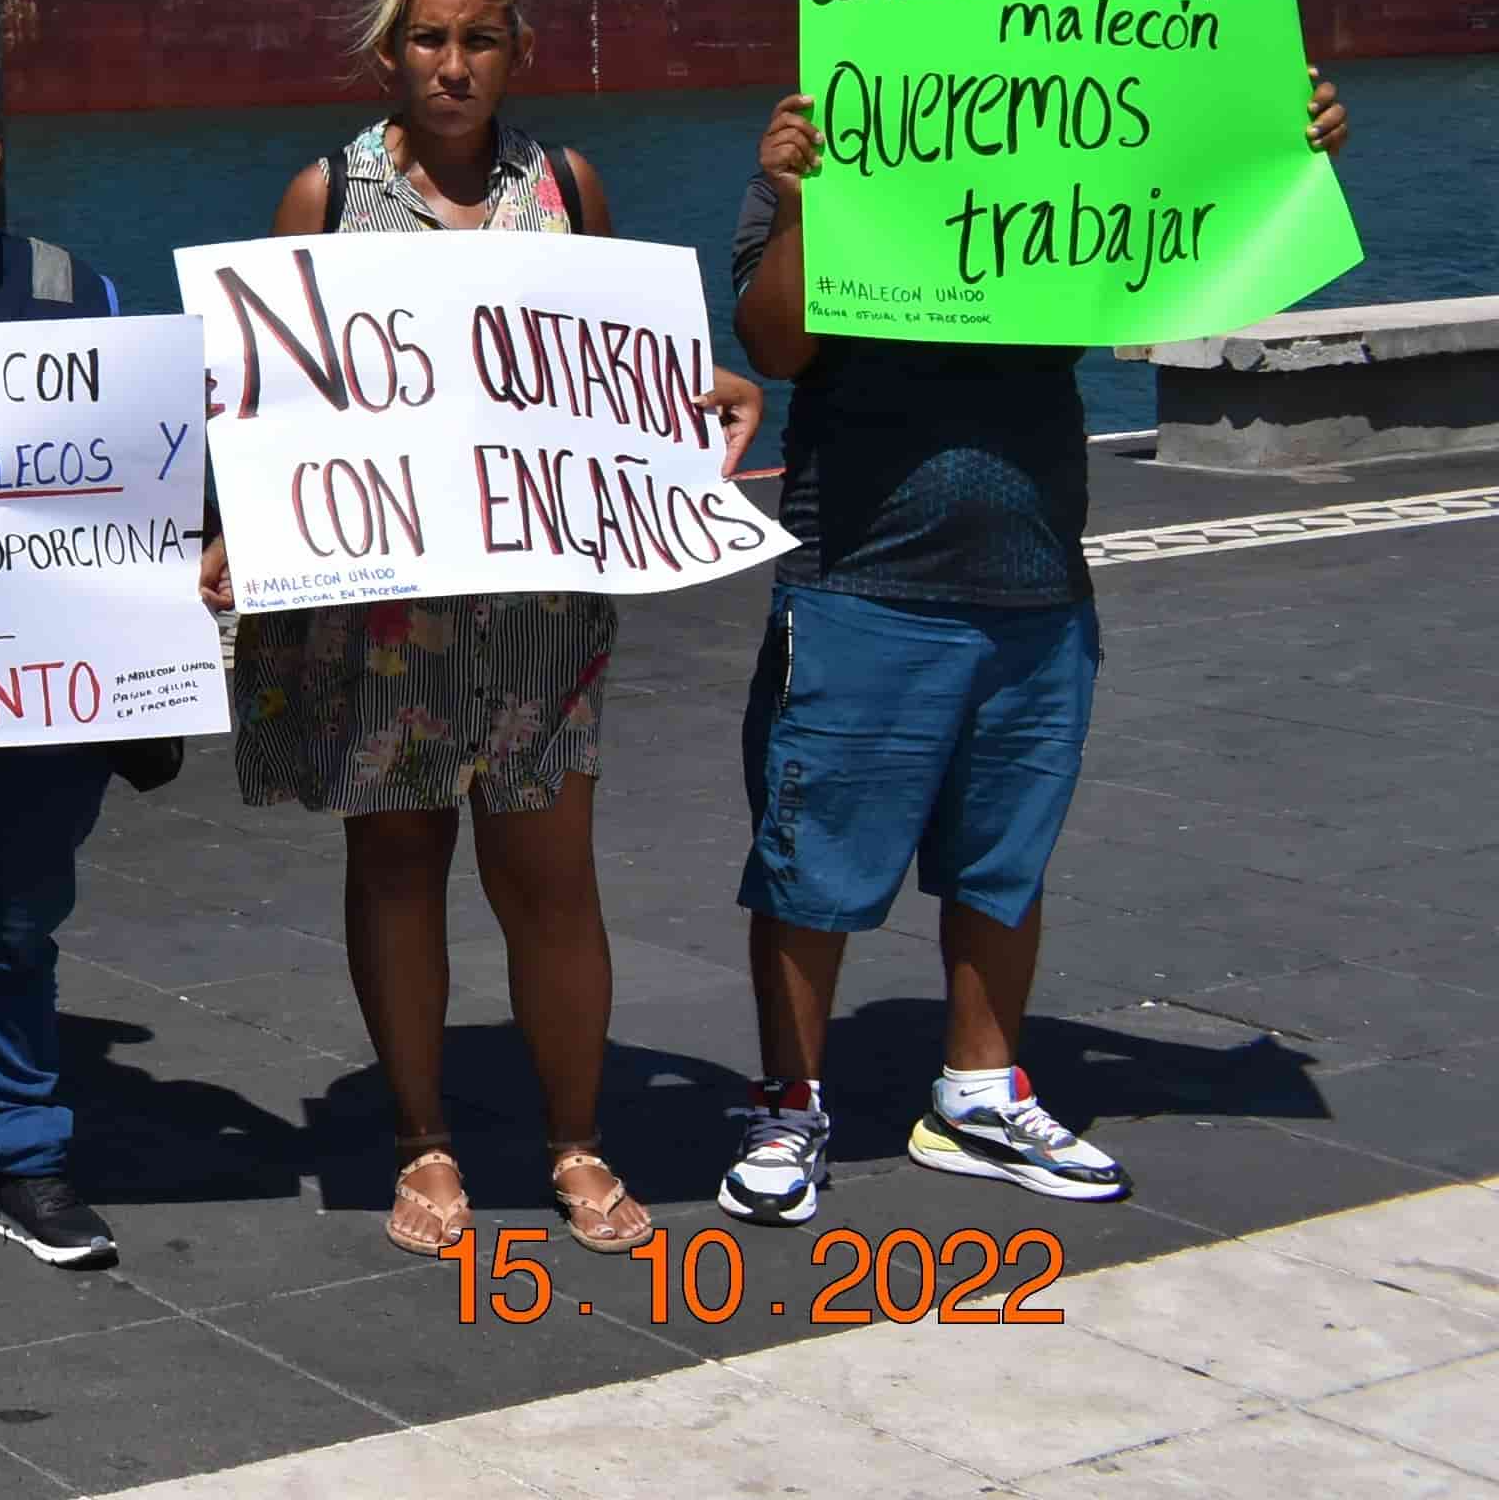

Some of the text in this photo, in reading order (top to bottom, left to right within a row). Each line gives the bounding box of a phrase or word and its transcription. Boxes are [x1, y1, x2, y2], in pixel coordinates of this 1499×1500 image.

[824, 60, 1150, 177] Queremos
[945, 183, 1216, 292] trabajar
[817, 276, 985, 302] #MALECON UNIDO
[3, 347, 99, 403] CON
[215, 248, 709, 449] NOS QUITARON
[159, 421, 189, 481] Y
[291, 444, 767, 573] CON ENGAÑOS
[243, 568, 396, 595] #MALECON UNIDO
[181, 661, 217, 673] UNIDO
